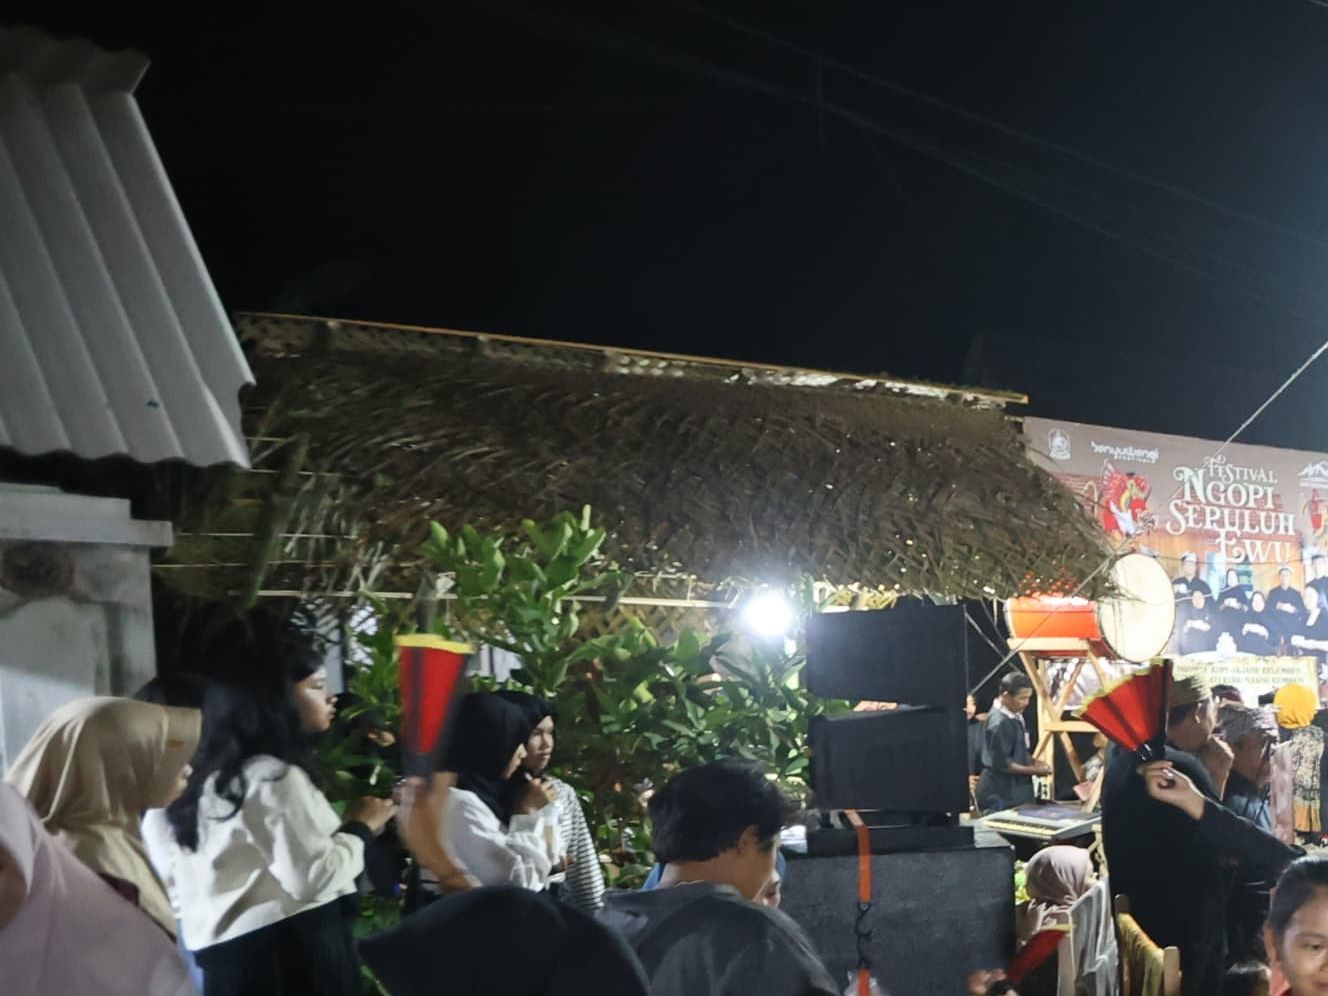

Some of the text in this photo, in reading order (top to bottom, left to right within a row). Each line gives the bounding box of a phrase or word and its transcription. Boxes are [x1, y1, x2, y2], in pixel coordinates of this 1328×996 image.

[1203, 454, 1278, 484] FESTIVAL
[1173, 466, 1275, 509] NGOPI
[1166, 500, 1296, 536] SEPULUH
[1213, 526, 1291, 563] EWU
